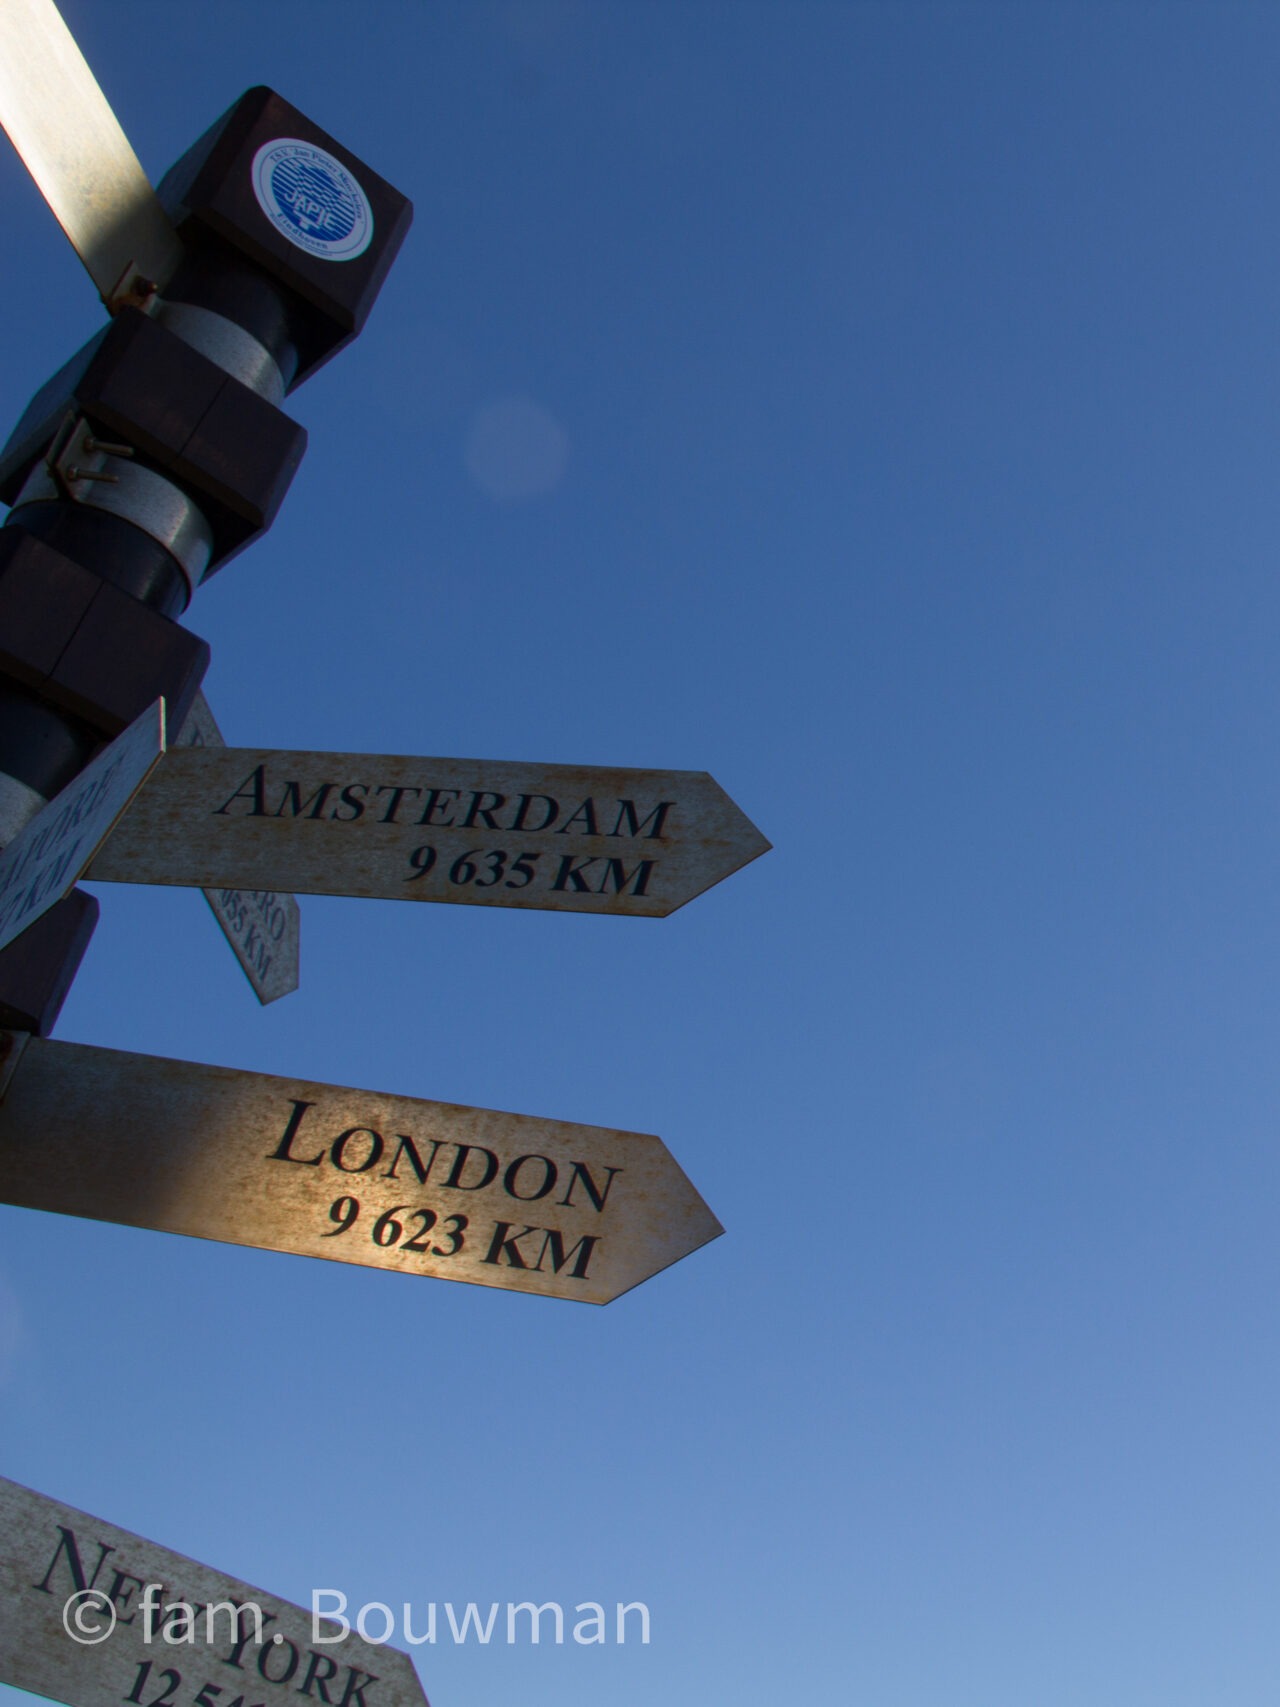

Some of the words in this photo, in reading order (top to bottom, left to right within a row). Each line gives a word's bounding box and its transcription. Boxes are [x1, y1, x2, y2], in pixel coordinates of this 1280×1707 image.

[211, 764, 678, 841] AMSTERDAM
[402, 845, 438, 882] 9
[449, 849, 543, 890] 635
[549, 854, 660, 897] KM
[243, 923, 272, 983] KM
[266, 1099, 623, 1214] LONDON
[320, 1195, 361, 1239] 9
[371, 1204, 470, 1257] 623
[480, 1219, 603, 1281] KM
[32, 1524, 207, 1639] NEW
[222, 1597, 381, 1707] YORK
[122, 1660, 183, 1707] 12
